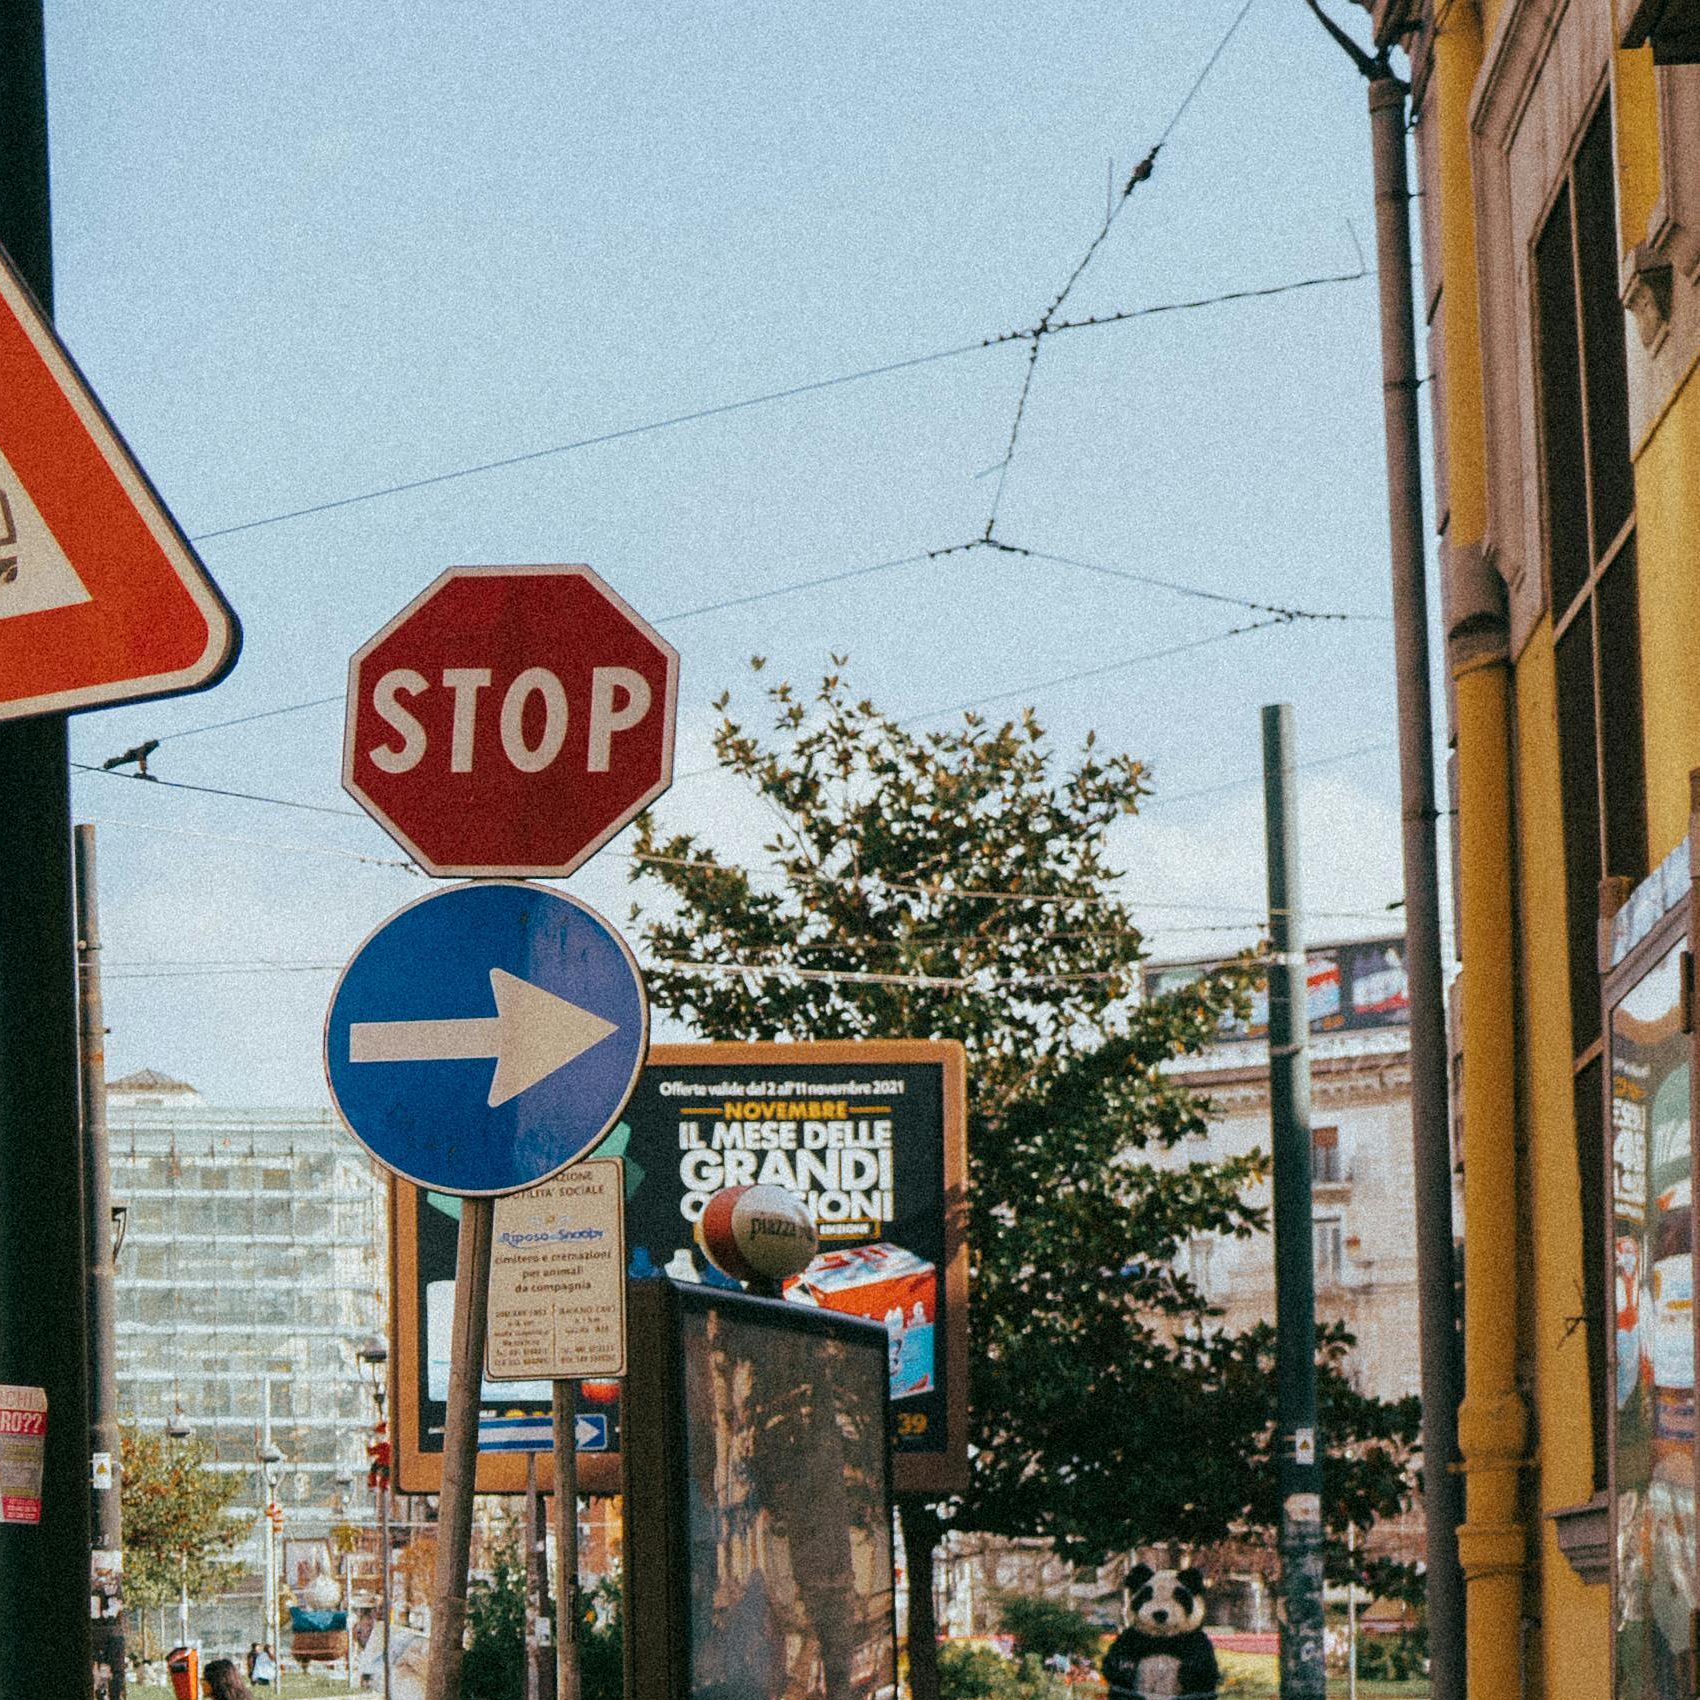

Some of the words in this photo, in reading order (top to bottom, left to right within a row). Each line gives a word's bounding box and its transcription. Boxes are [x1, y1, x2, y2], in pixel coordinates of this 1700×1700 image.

[369, 666, 653, 774] STOP
[659, 1080, 707, 1096] Offerte
[708, 1080, 745, 1096] valide
[767, 1081, 777, 1096] 2
[808, 1080, 871, 1096] novembre
[872, 1079, 905, 1095] 2021
[723, 1100, 848, 1120] NOVEMBRE
[679, 1121, 707, 1150] IL
[711, 1121, 798, 1150] MESE
[802, 1120, 893, 1150] DELLE
[679, 1148, 894, 1192] GRANDI
[559, 1184, 605, 1197] SOCIALE
[502, 1230, 549, 1244] Riposo
[495, 1254, 540, 1265] cimitero
[551, 1249, 612, 1262] cremazioni
[522, 1270, 540, 1280] per
[542, 1265, 584, 1277] animali
[514, 1282, 528, 1293] da
[530, 1281, 592, 1293] compagnia
